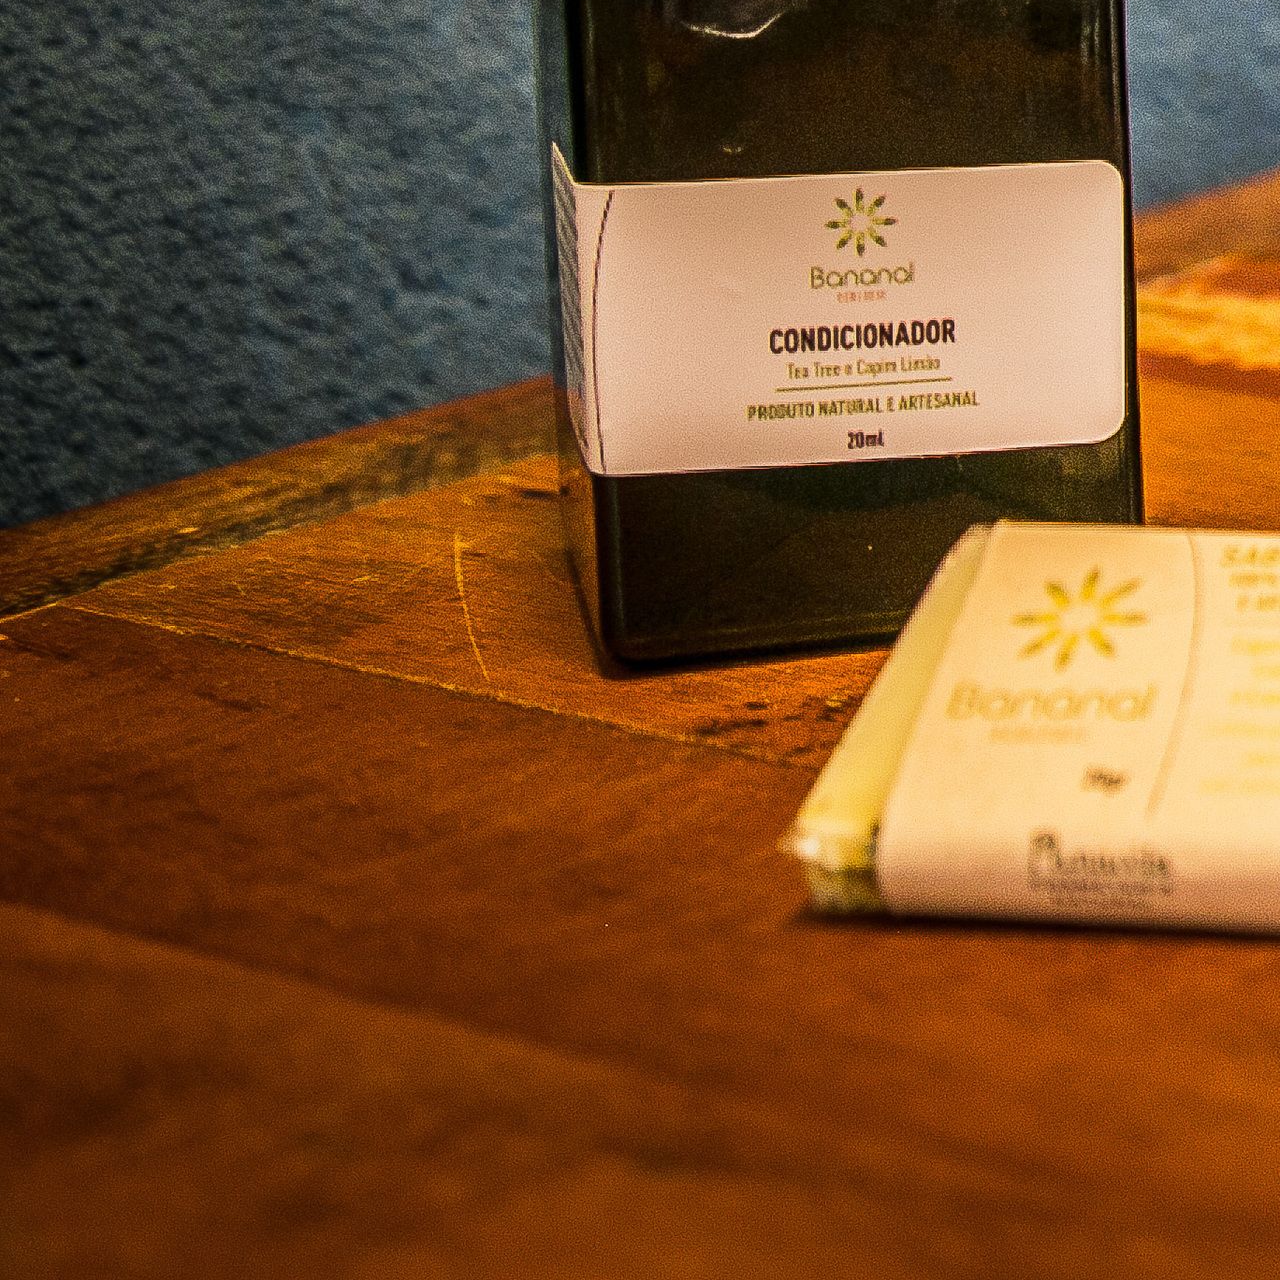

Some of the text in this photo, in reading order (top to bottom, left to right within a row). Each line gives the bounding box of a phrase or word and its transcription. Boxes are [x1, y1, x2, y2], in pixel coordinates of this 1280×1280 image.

[810, 262, 915, 289] Bananal
[769, 318, 955, 354] CONDICIONADOR
[747, 390, 979, 420] PRODUTO NATURAL E ARTESANAL
[946, 680, 1158, 721] Bananal
